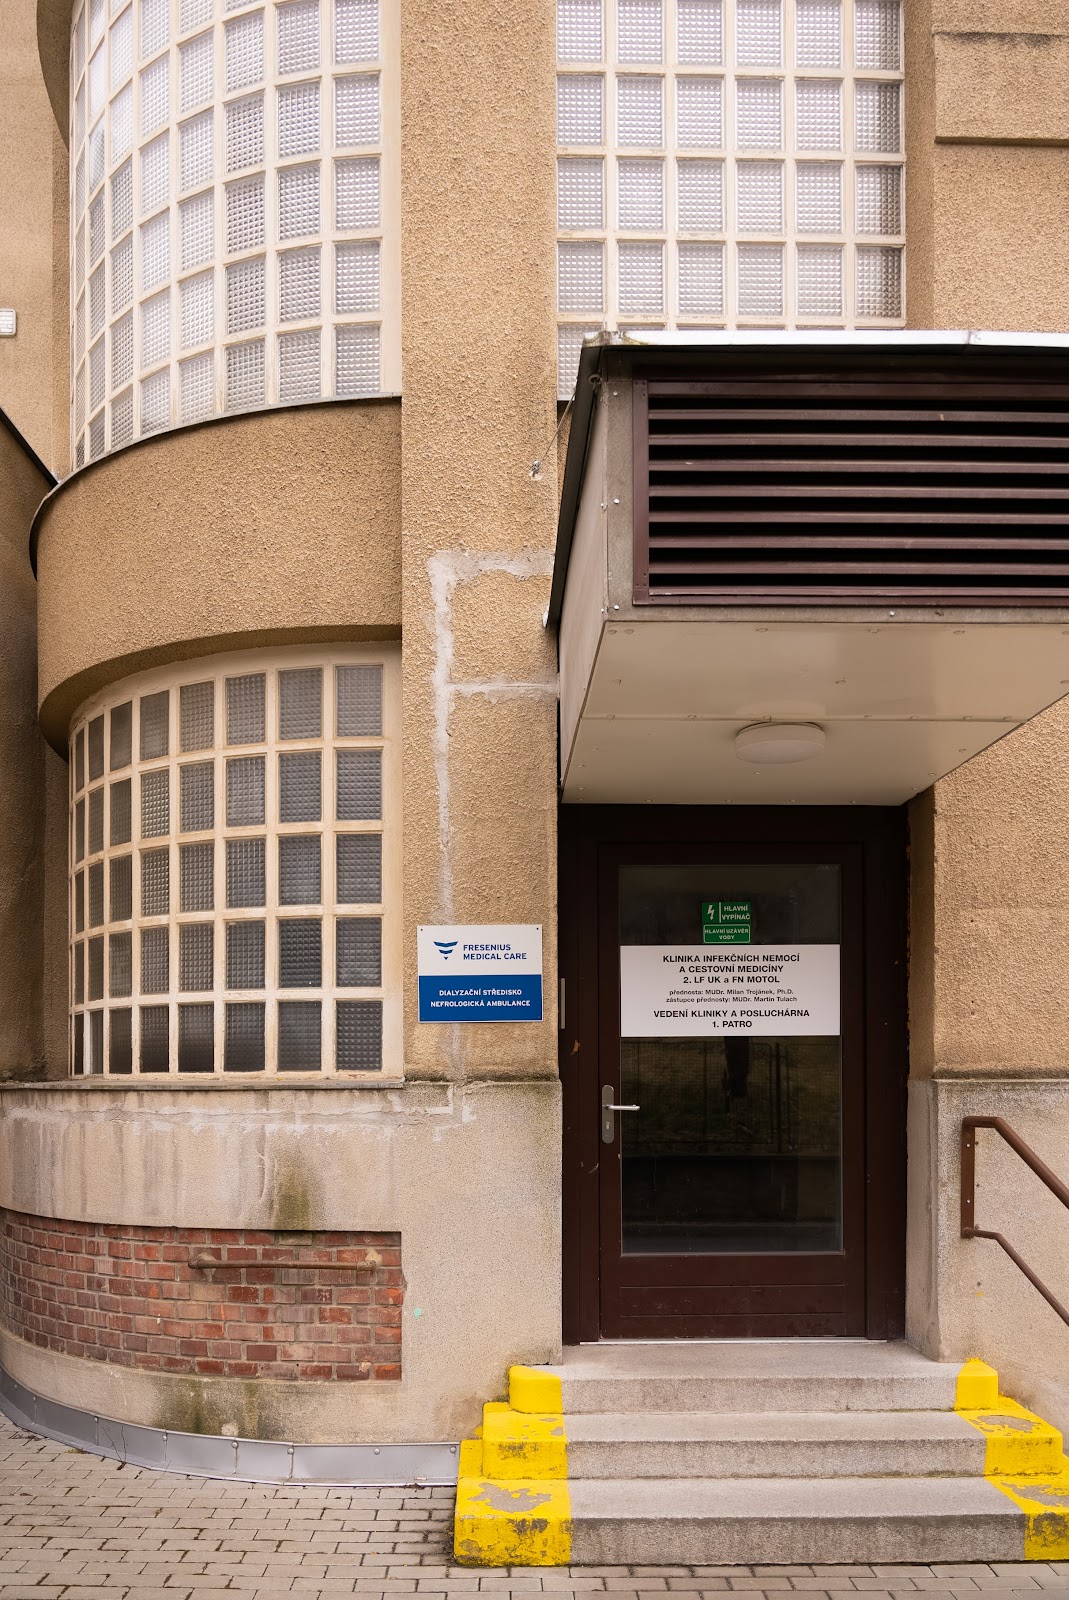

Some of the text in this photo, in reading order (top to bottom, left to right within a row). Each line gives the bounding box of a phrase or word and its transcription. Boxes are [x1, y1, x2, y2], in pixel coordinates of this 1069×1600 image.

[703, 953, 760, 962] INFEKČNÍCH
[762, 953, 800, 962] NEMOCÍ
[688, 964, 735, 973] CESTOVNÍ
[738, 964, 784, 972] MEDICÍNY
[653, 1009, 688, 1018] VEDENÍ
[740, 1008, 810, 1017] POSLUCHÁRNA
